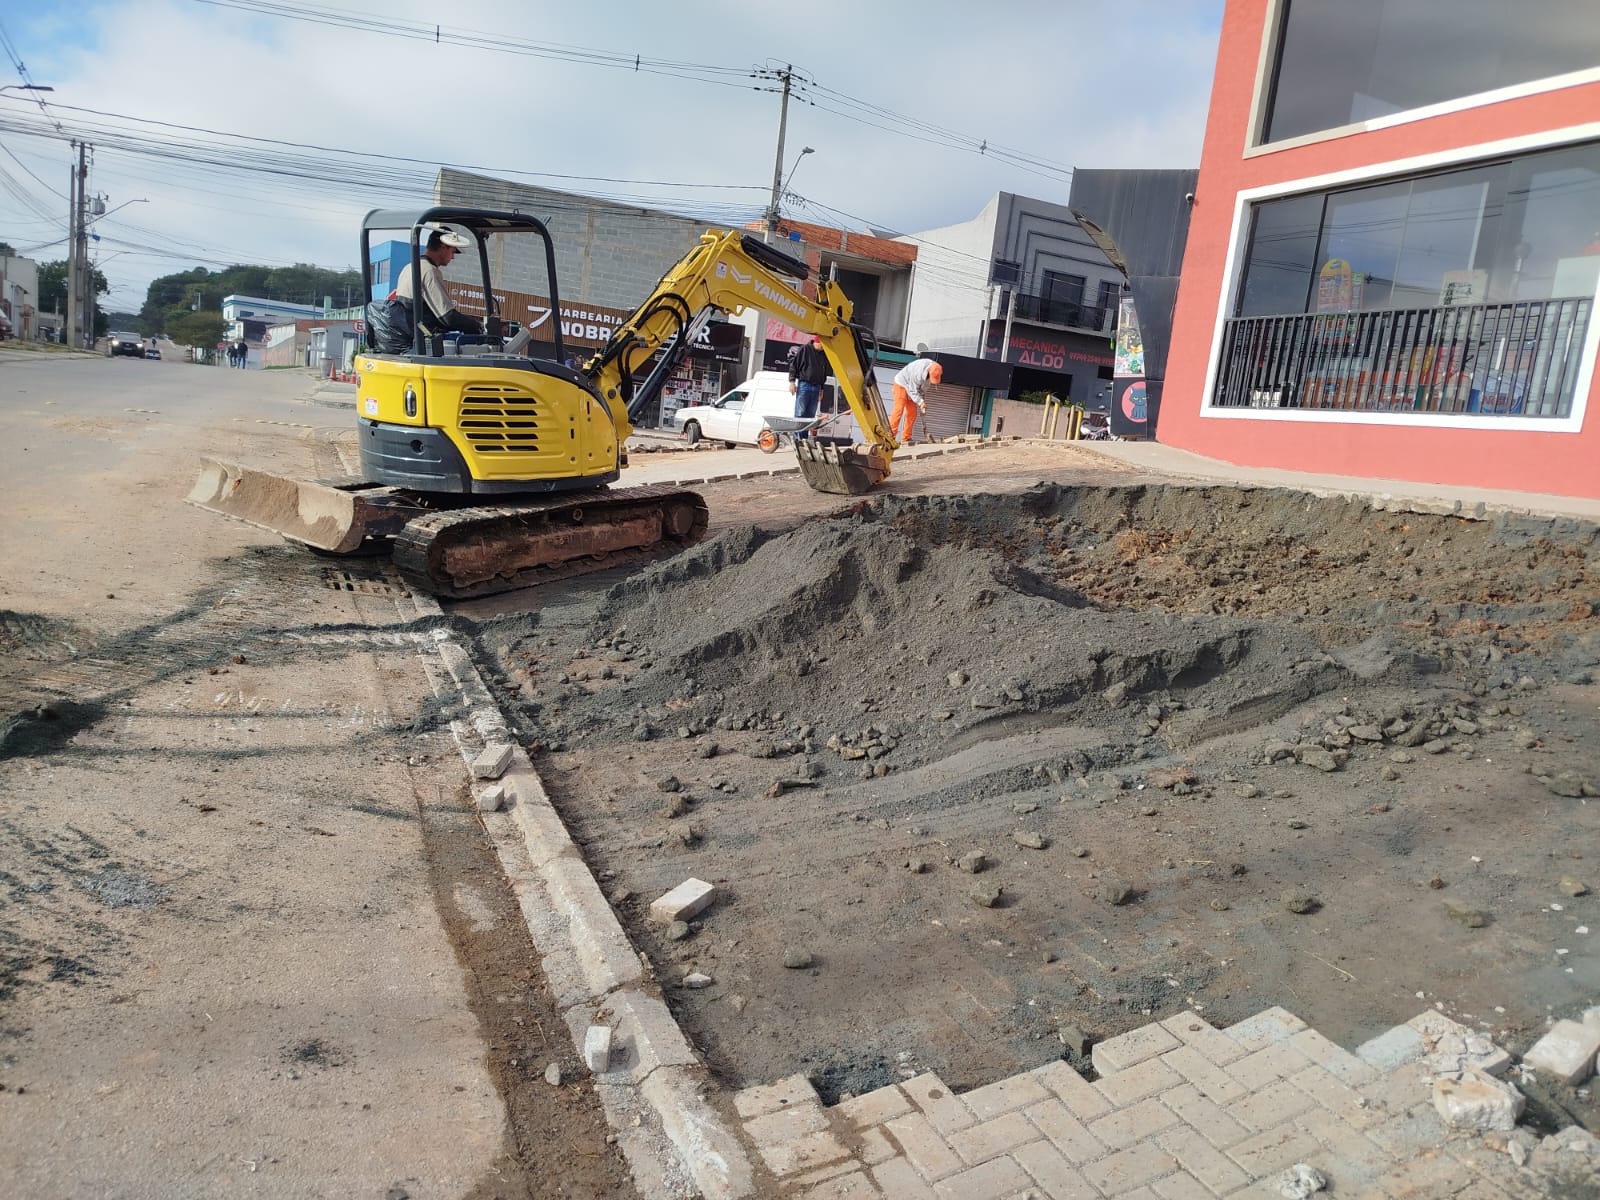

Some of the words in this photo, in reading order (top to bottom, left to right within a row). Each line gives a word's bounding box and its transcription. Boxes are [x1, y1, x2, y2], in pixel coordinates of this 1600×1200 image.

[754, 279, 807, 319] YANMAR
[560, 321, 612, 343] NOBR
[1009, 336, 1066, 356] MECANICA
[1018, 350, 1064, 369] ALDO
